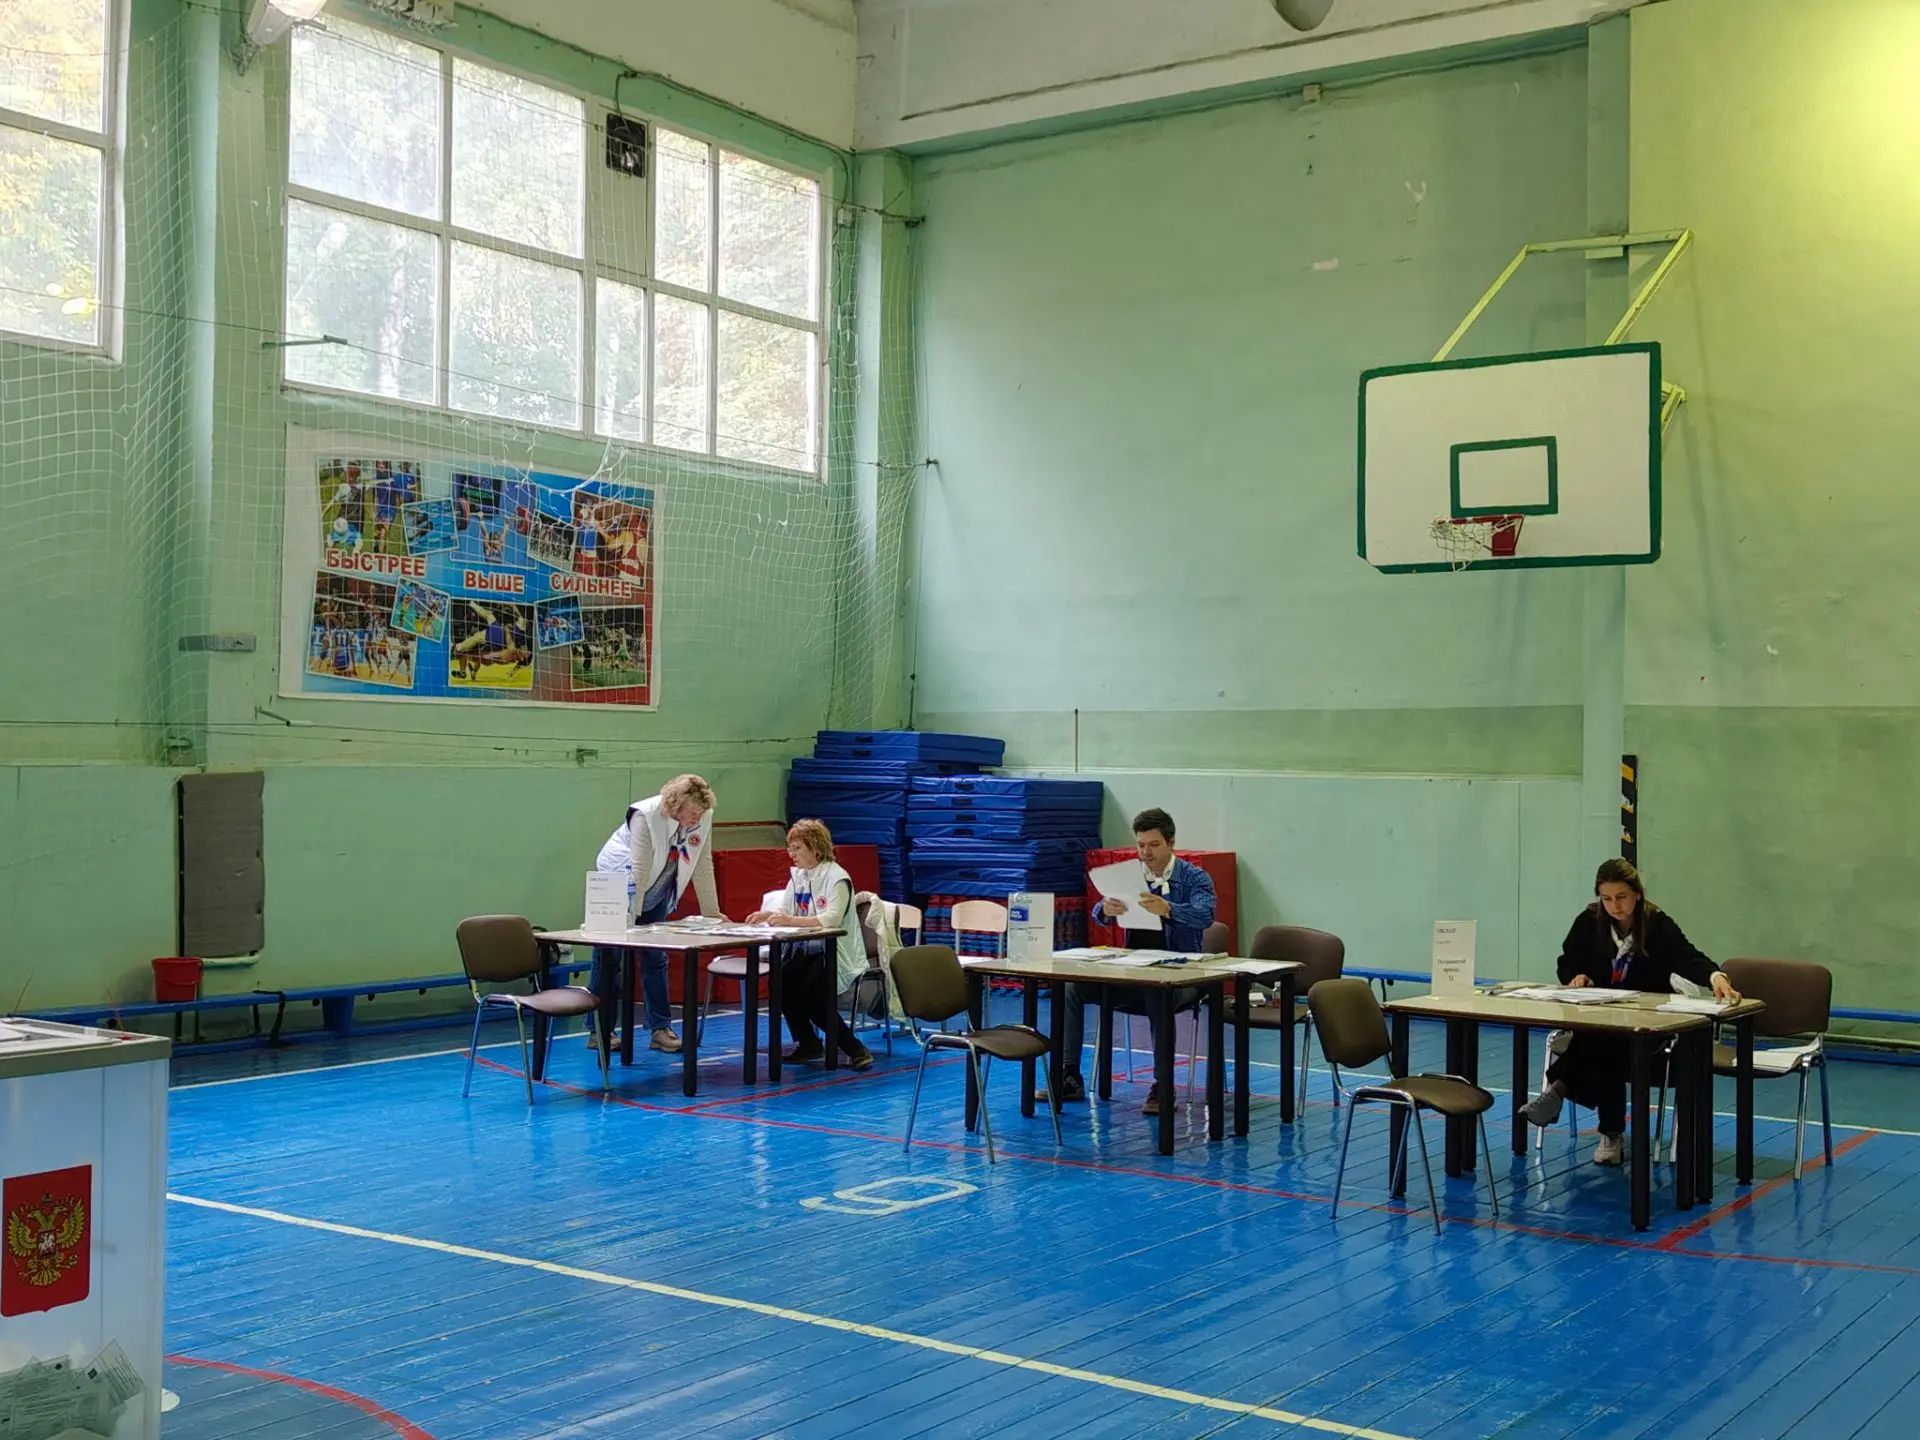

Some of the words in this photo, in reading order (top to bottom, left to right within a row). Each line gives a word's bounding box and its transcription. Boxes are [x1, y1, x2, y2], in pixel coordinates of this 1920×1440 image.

[327, 549, 426, 577] БЫСТРЕЕ
[465, 571, 524, 594] ВЫШЕ
[551, 572, 632, 597] СИЛЬНЕЕ
